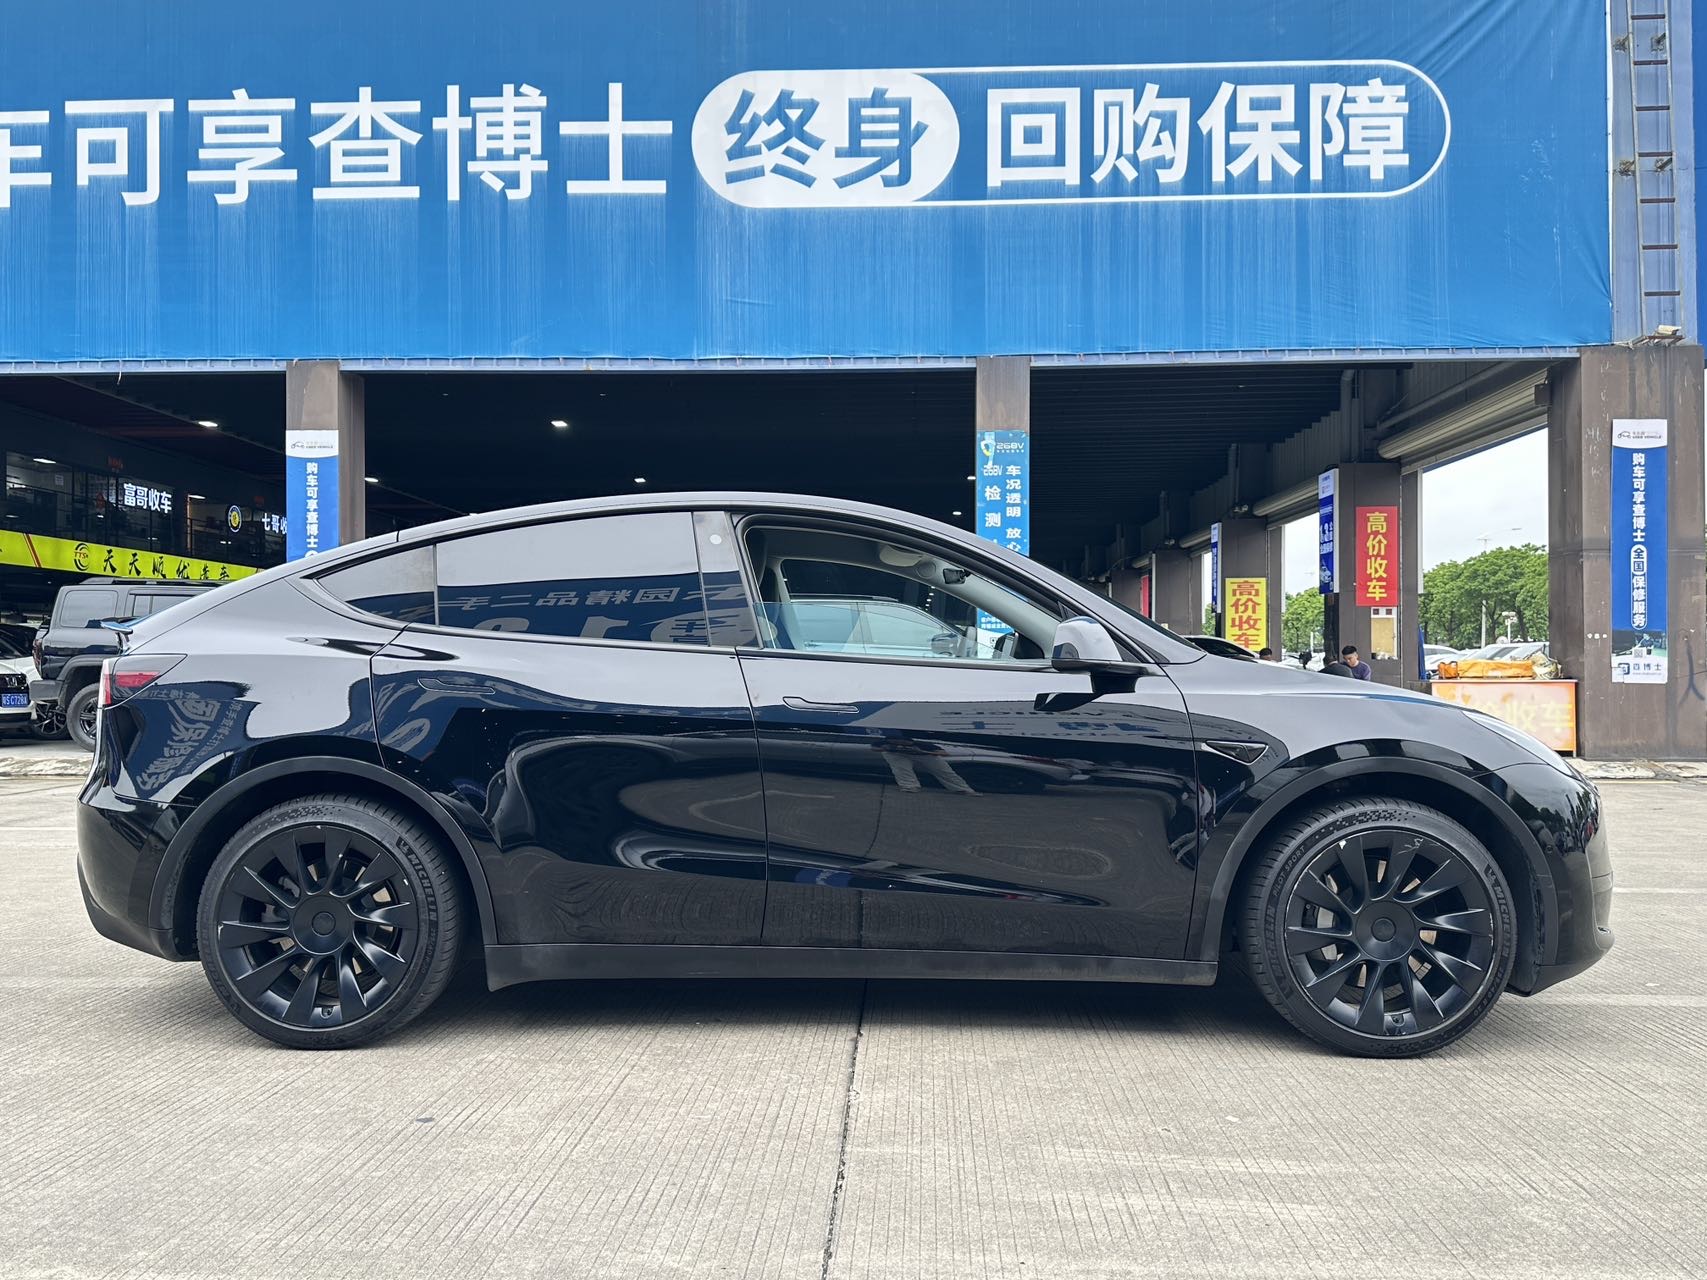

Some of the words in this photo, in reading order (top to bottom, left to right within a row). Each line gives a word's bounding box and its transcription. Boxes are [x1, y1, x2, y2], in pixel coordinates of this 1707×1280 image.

[724, 87, 929, 190] 终身
[986, 77, 1411, 187] 回购保障
[123, 482, 173, 514] 富哥收车
[1366, 511, 1388, 602] 高价收车
[1230, 580, 1262, 648] 高价收车
[408, 853, 437, 921] MICHELIN
